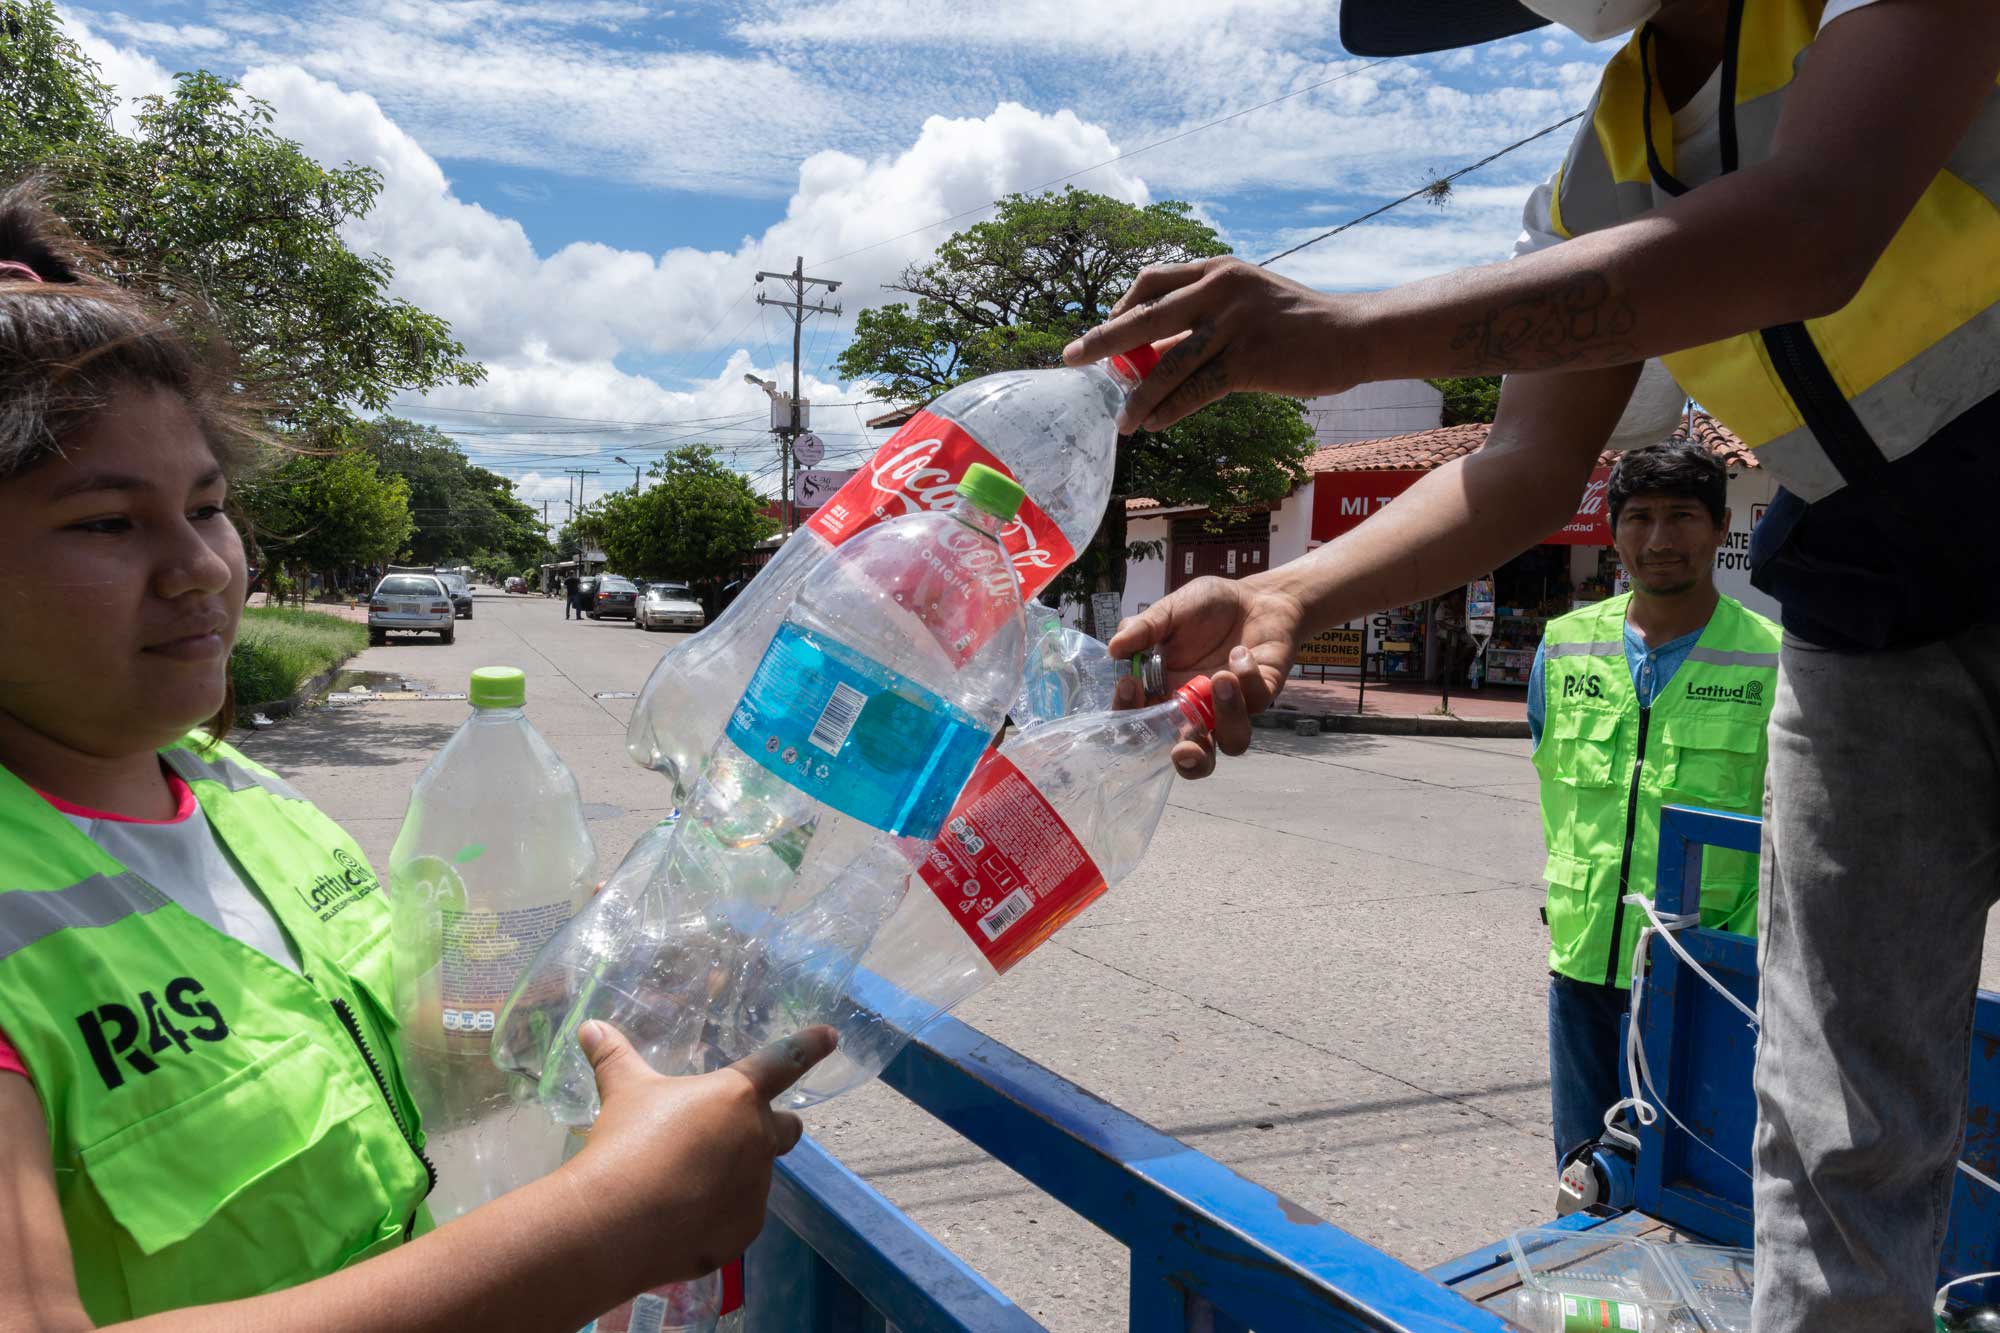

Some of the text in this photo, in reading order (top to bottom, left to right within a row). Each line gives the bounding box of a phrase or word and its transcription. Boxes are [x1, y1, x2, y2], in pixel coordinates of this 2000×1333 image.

[870, 438, 962, 514] Coca
[1341, 497, 1369, 515] MI
[1687, 682, 1743, 698] Latitud
